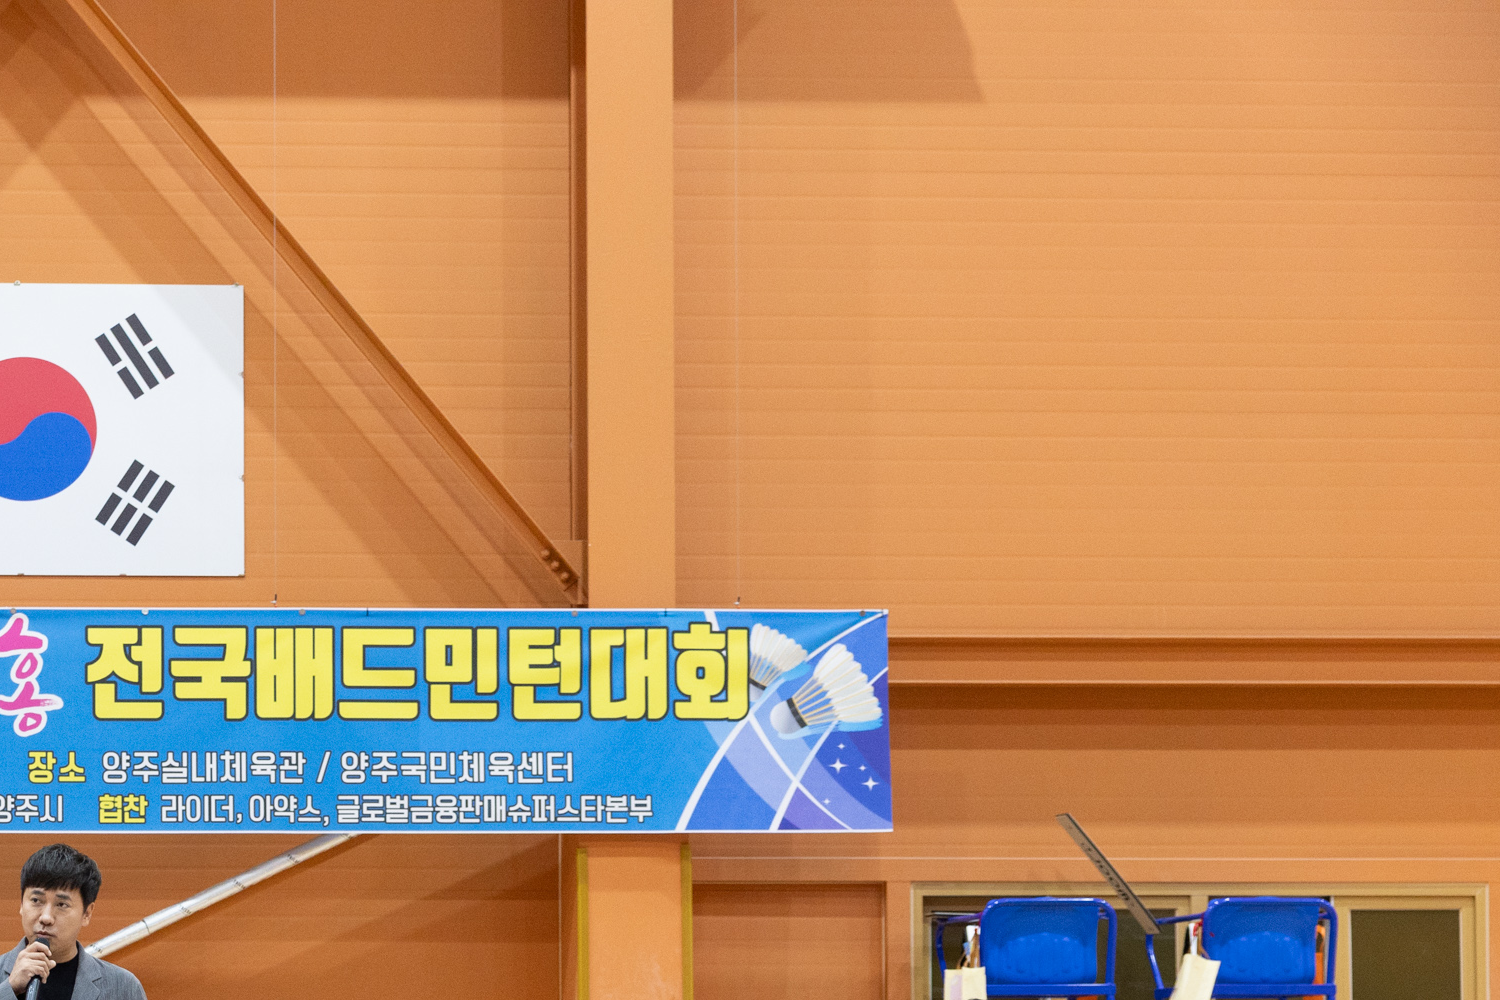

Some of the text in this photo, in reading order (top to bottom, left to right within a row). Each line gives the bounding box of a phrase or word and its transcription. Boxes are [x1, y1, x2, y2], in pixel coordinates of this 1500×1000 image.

[85, 621, 750, 722] 전국배드민턴대회
[28, 751, 86, 783] 장소
[102, 751, 307, 784] 양주실내체육관
[317, 751, 331, 783] /
[341, 751, 573, 784] 양주국민체육센터
[99, 794, 148, 823] 협찬
[161, 795, 243, 825] 라이더,
[249, 795, 329, 826] 아약스,
[336, 795, 653, 823] 글로벌금융판매슈퍼스타본부
